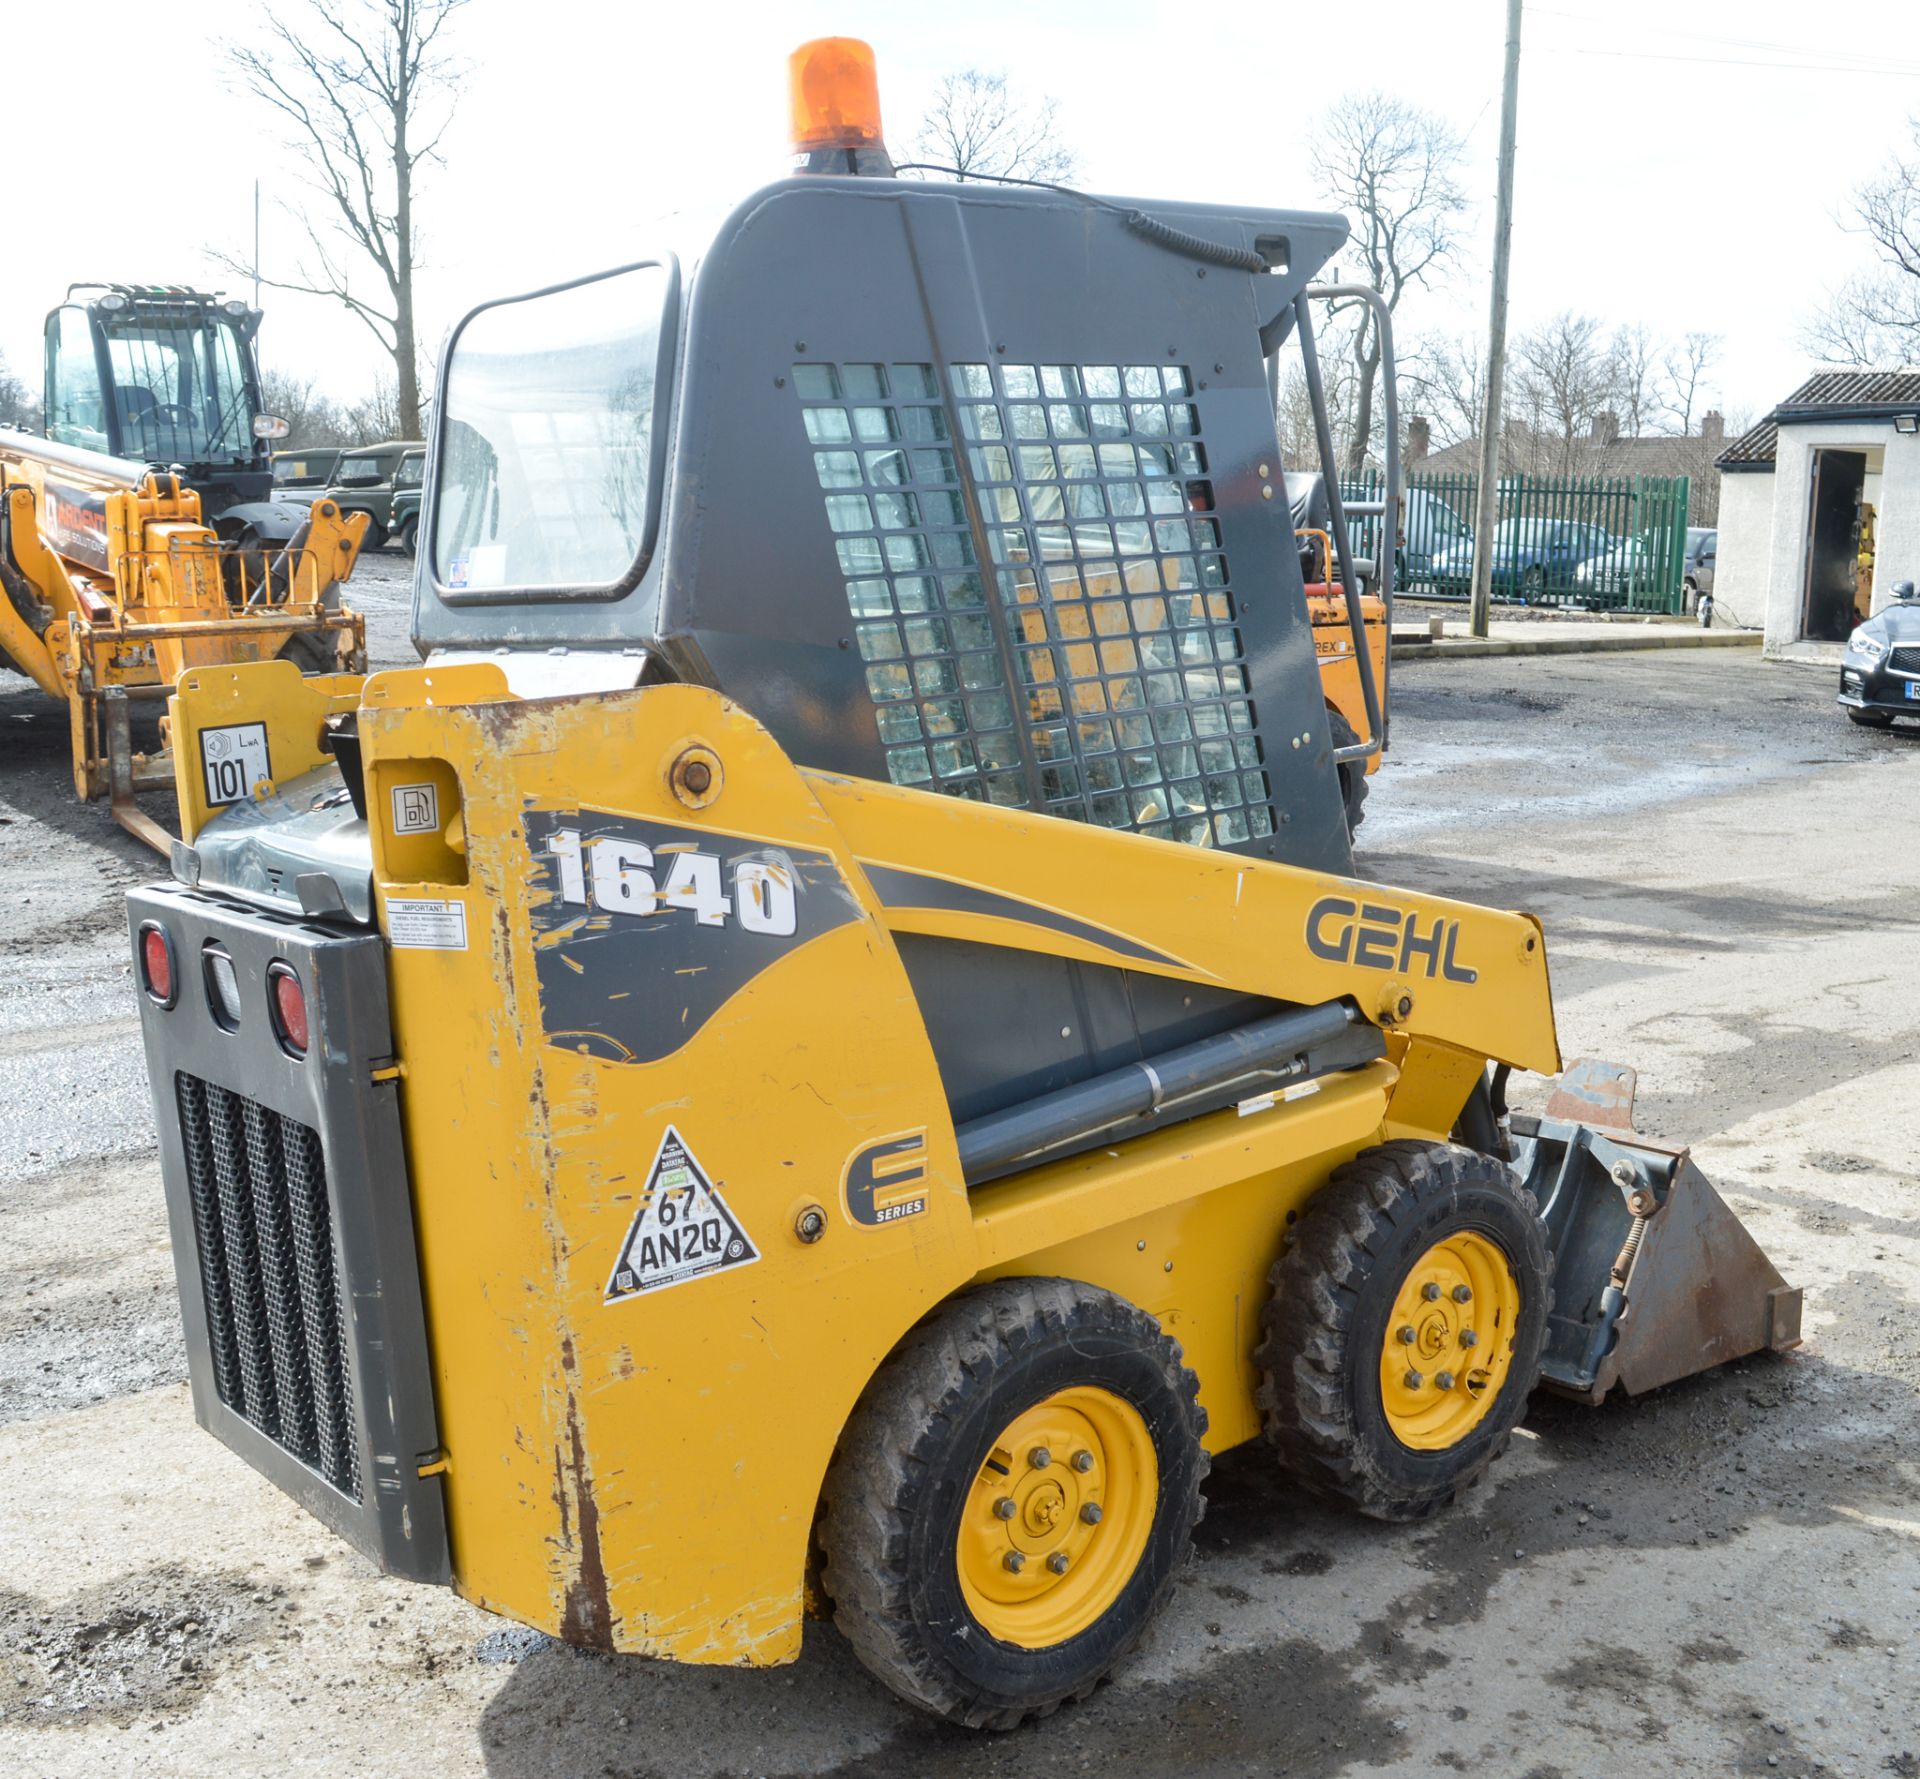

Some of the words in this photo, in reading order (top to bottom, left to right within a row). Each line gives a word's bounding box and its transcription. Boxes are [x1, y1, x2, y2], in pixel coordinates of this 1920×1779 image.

[58, 501, 106, 534] ARDENT
[71, 531, 106, 555] SOLUTIONS
[208, 758, 248, 800] 101
[546, 827, 799, 938] 1640
[402, 904, 443, 912] IMPORTANT
[1305, 895, 1479, 985] GEHL
[658, 1184, 696, 1226] 67
[876, 1200, 922, 1223] SERIES
[639, 1217, 722, 1273] AN2Q
